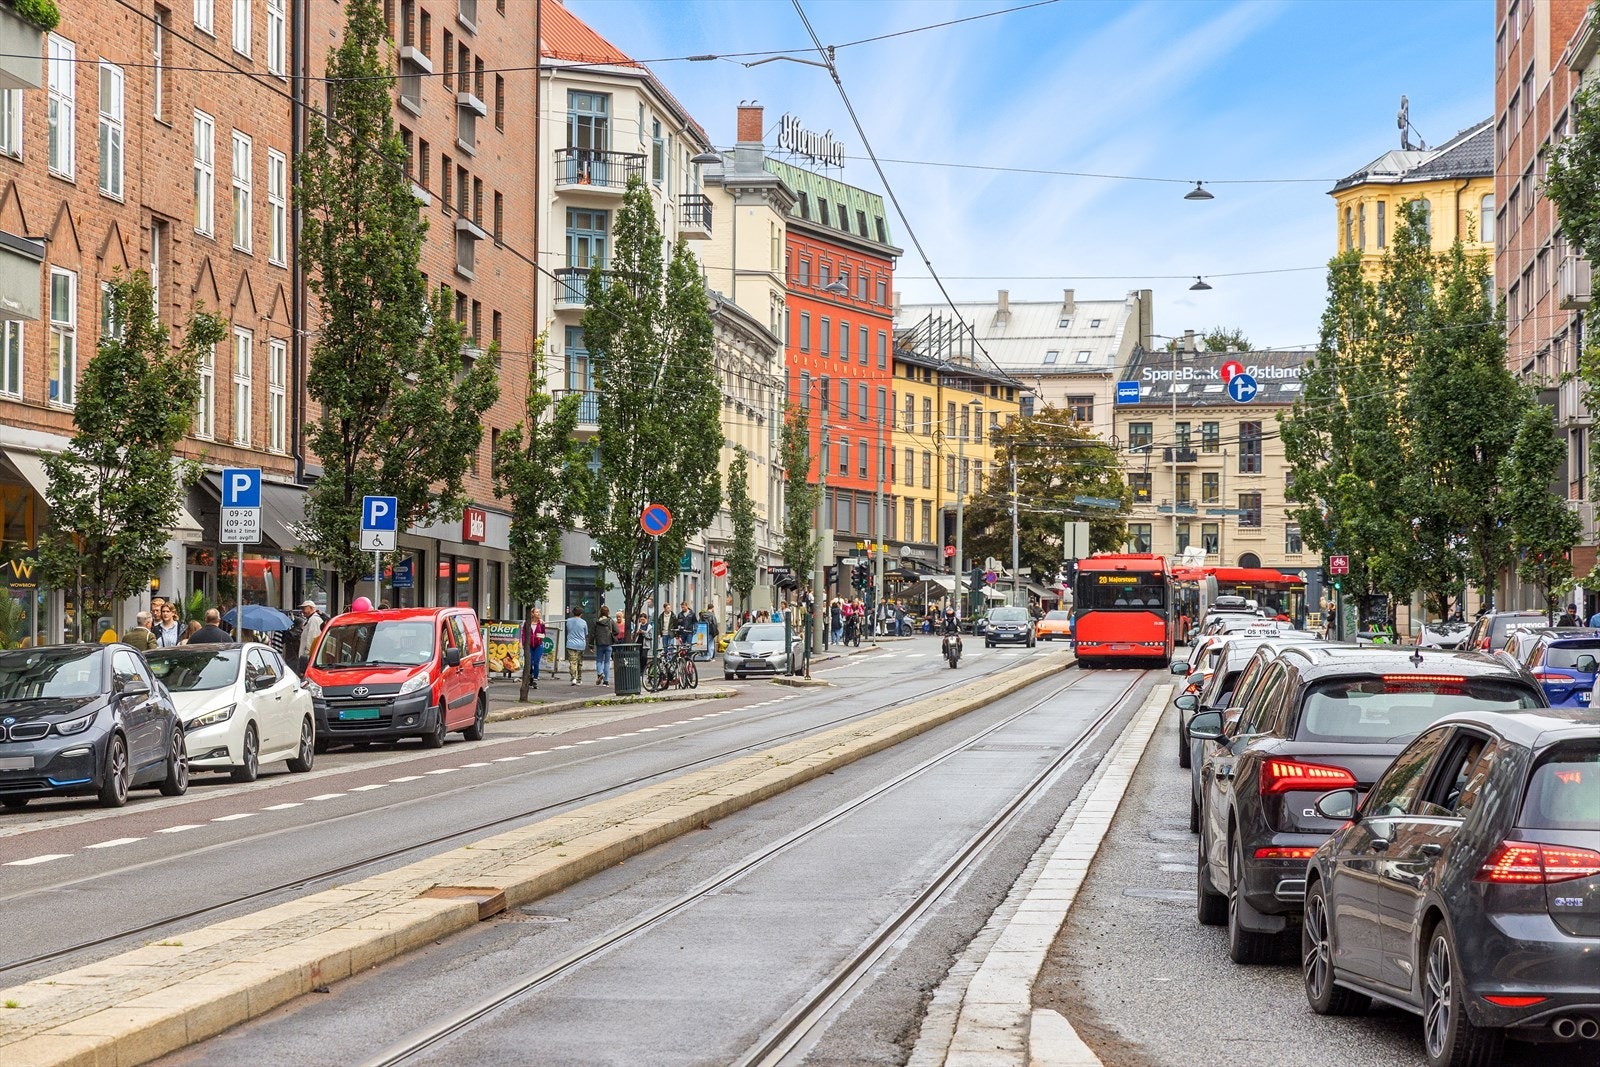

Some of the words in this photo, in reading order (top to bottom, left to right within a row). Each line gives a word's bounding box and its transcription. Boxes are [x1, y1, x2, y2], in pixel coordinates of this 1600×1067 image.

[778, 111, 844, 168] Aftenposten
[1142, 366, 1218, 383] SpareBank
[231, 473, 252, 503] P
[370, 500, 389, 526] P
[239, 534, 254, 542] avgift
[1099, 576, 1108, 584] 20
[488, 621, 517, 634] oker
[1554, 896, 1584, 907] GTE
